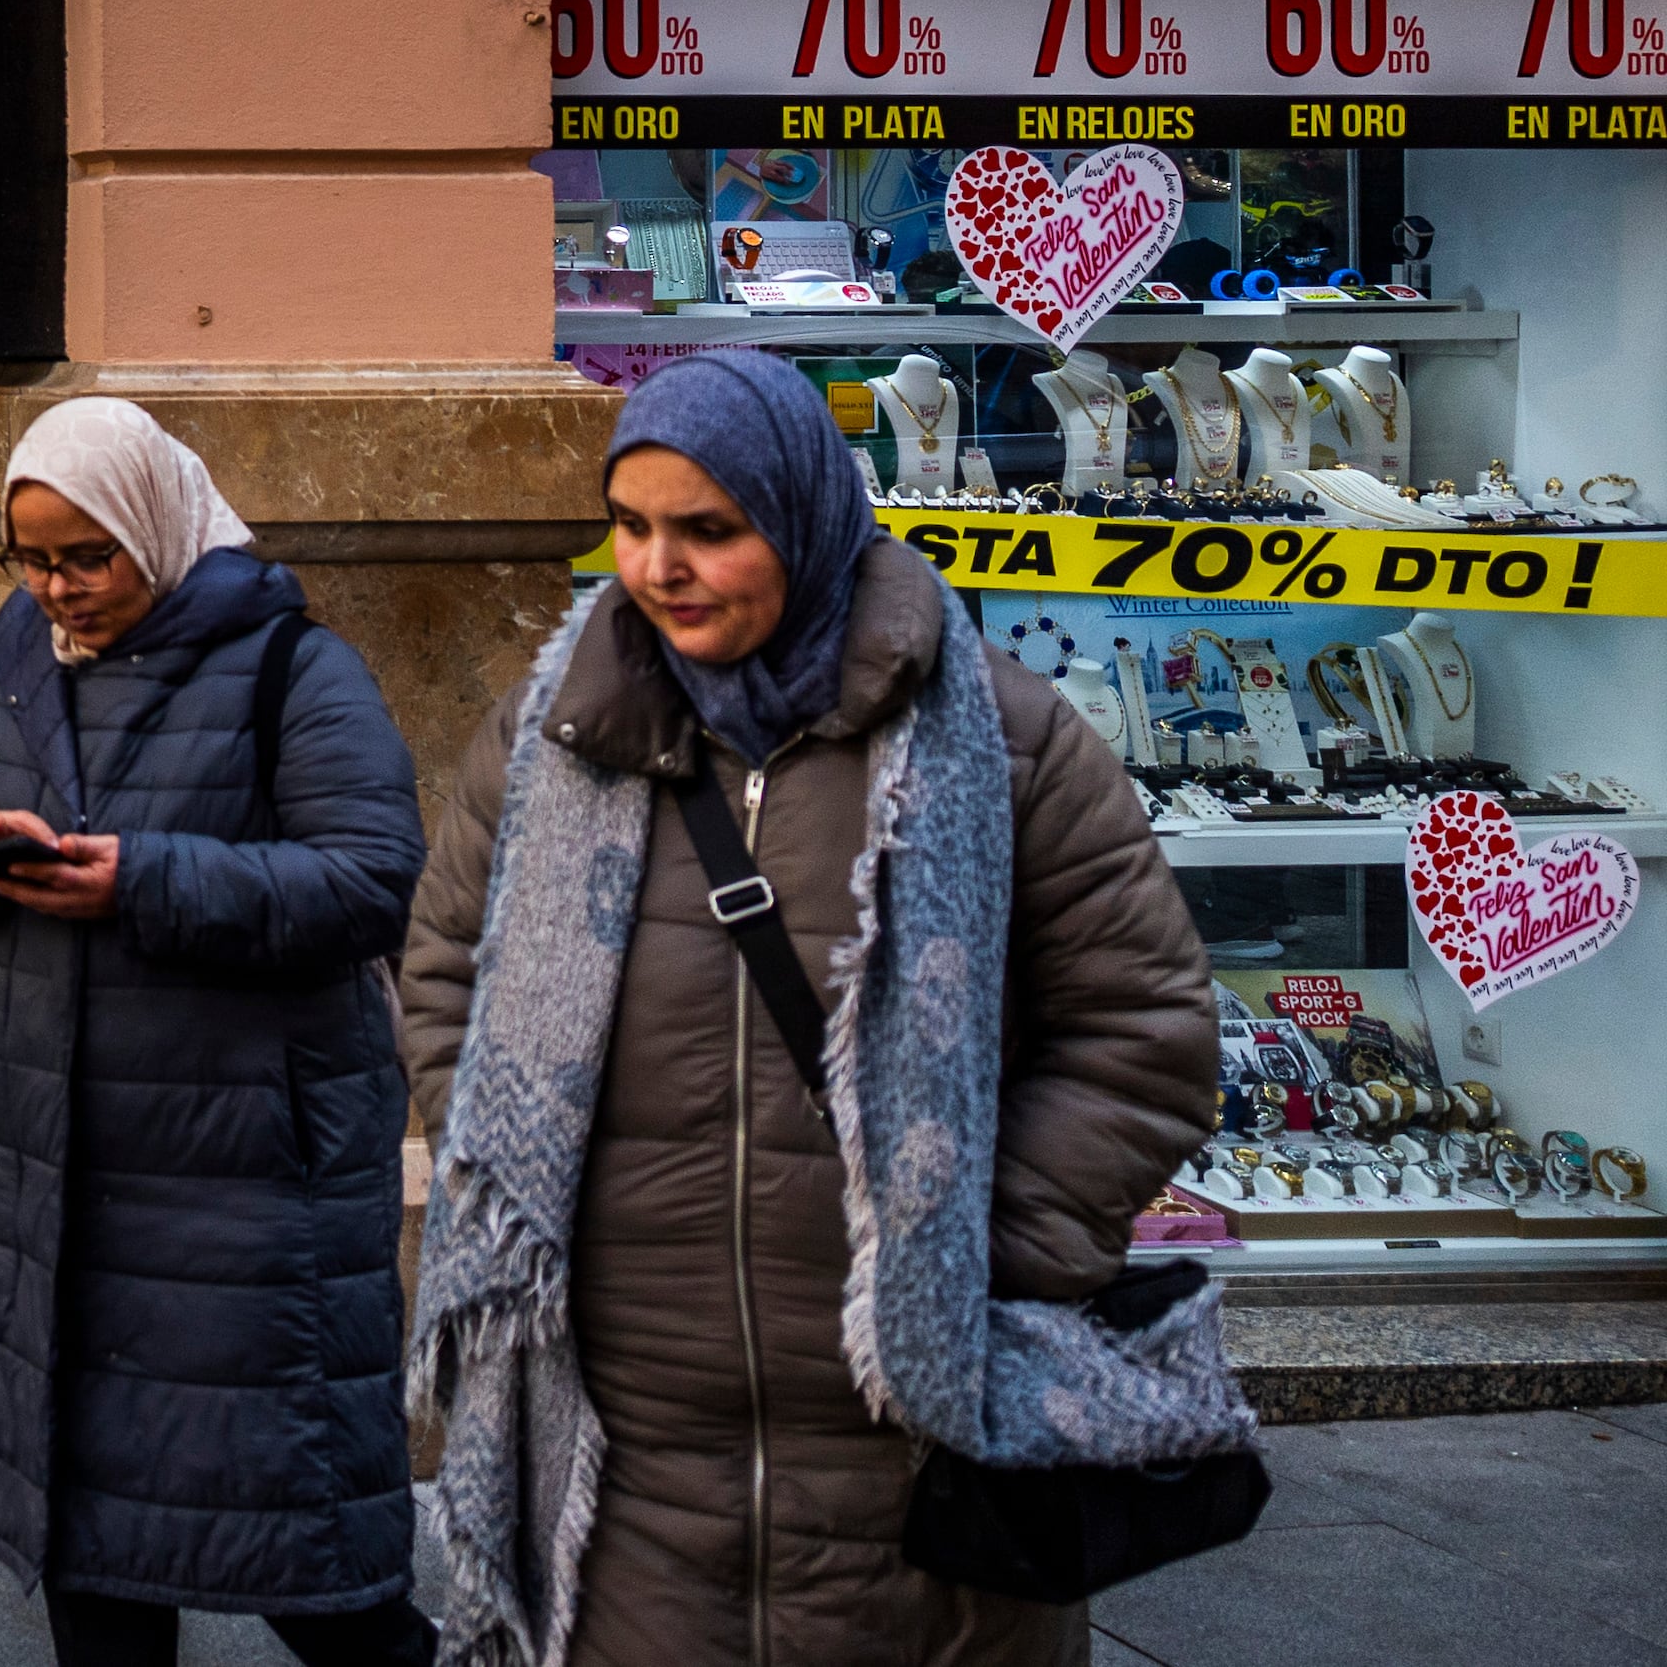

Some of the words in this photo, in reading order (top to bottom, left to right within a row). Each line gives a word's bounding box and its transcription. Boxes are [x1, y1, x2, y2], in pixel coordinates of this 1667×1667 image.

[661, 52, 704, 76] DTO
[904, 52, 946, 76] DTO
[1145, 52, 1187, 75] DTO
[1387, 51, 1430, 74] DTO
[1627, 53, 1667, 76] DTO
[562, 106, 605, 140] EN
[614, 106, 679, 140] ORO
[783, 106, 824, 139] EN
[843, 106, 945, 139] PLATA
[1018, 106, 1066, 139] EN
[1069, 106, 1195, 140] RELOJES
[1290, 104, 1333, 137] EN
[1341, 104, 1406, 137] ORO
[1508, 107, 1549, 139] EN
[1568, 107, 1667, 139] PLATA
[1101, 151, 1121, 169] love
[1124, 146, 1145, 159] love
[1147, 152, 1165, 172] love
[1085, 164, 1105, 178] love
[1082, 163, 1135, 217] San
[1163, 174, 1178, 195] love
[1168, 199, 1182, 220] love
[1023, 214, 1084, 271] Feliz
[1157, 222, 1175, 243] love
[1143, 243, 1162, 260] love
[1128, 261, 1147, 281] love
[1111, 277, 1130, 295] love
[1091, 292, 1111, 311] love
[1075, 309, 1094, 328] love
[1054, 323, 1073, 342] love
[625, 343, 647, 356] 14
[881, 523, 1056, 577] STA
[1091, 522, 1348, 600] 70%
[1107, 595, 1179, 614] Winter
[1186, 596, 1292, 613] Collection
[1541, 850, 1598, 893] San
[1469, 881, 1535, 925] Feliz
[1287, 979, 1340, 993] RELOJ
[1278, 995, 1357, 1009] SPORT-G
[1297, 1011, 1347, 1025] ROCK
